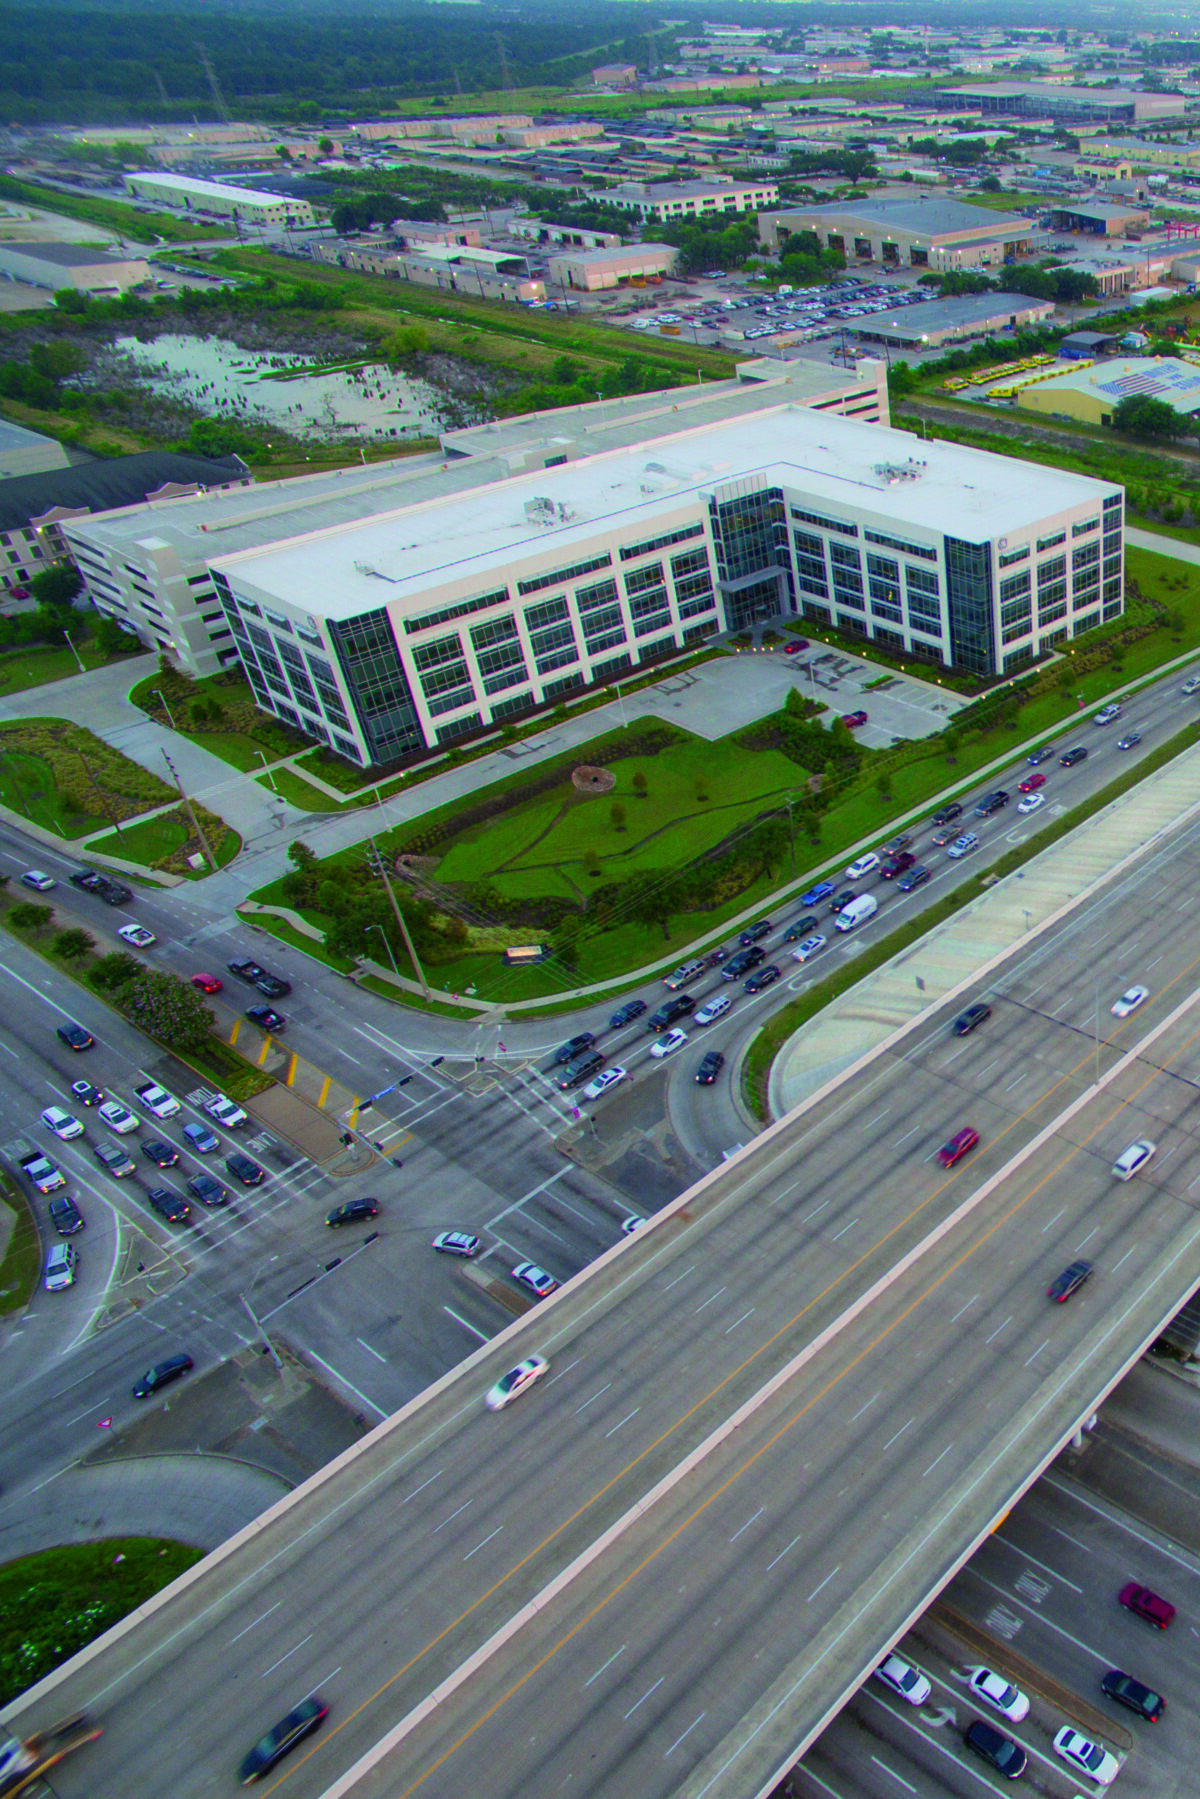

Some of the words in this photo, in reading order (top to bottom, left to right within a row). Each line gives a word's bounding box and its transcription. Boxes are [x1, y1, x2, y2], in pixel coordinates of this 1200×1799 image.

[185, 1086, 217, 1107] TURN
[246, 1131, 278, 1153] LANE
[1014, 1568, 1053, 1604] ONLY
[985, 1602, 1024, 1640] ONLY
